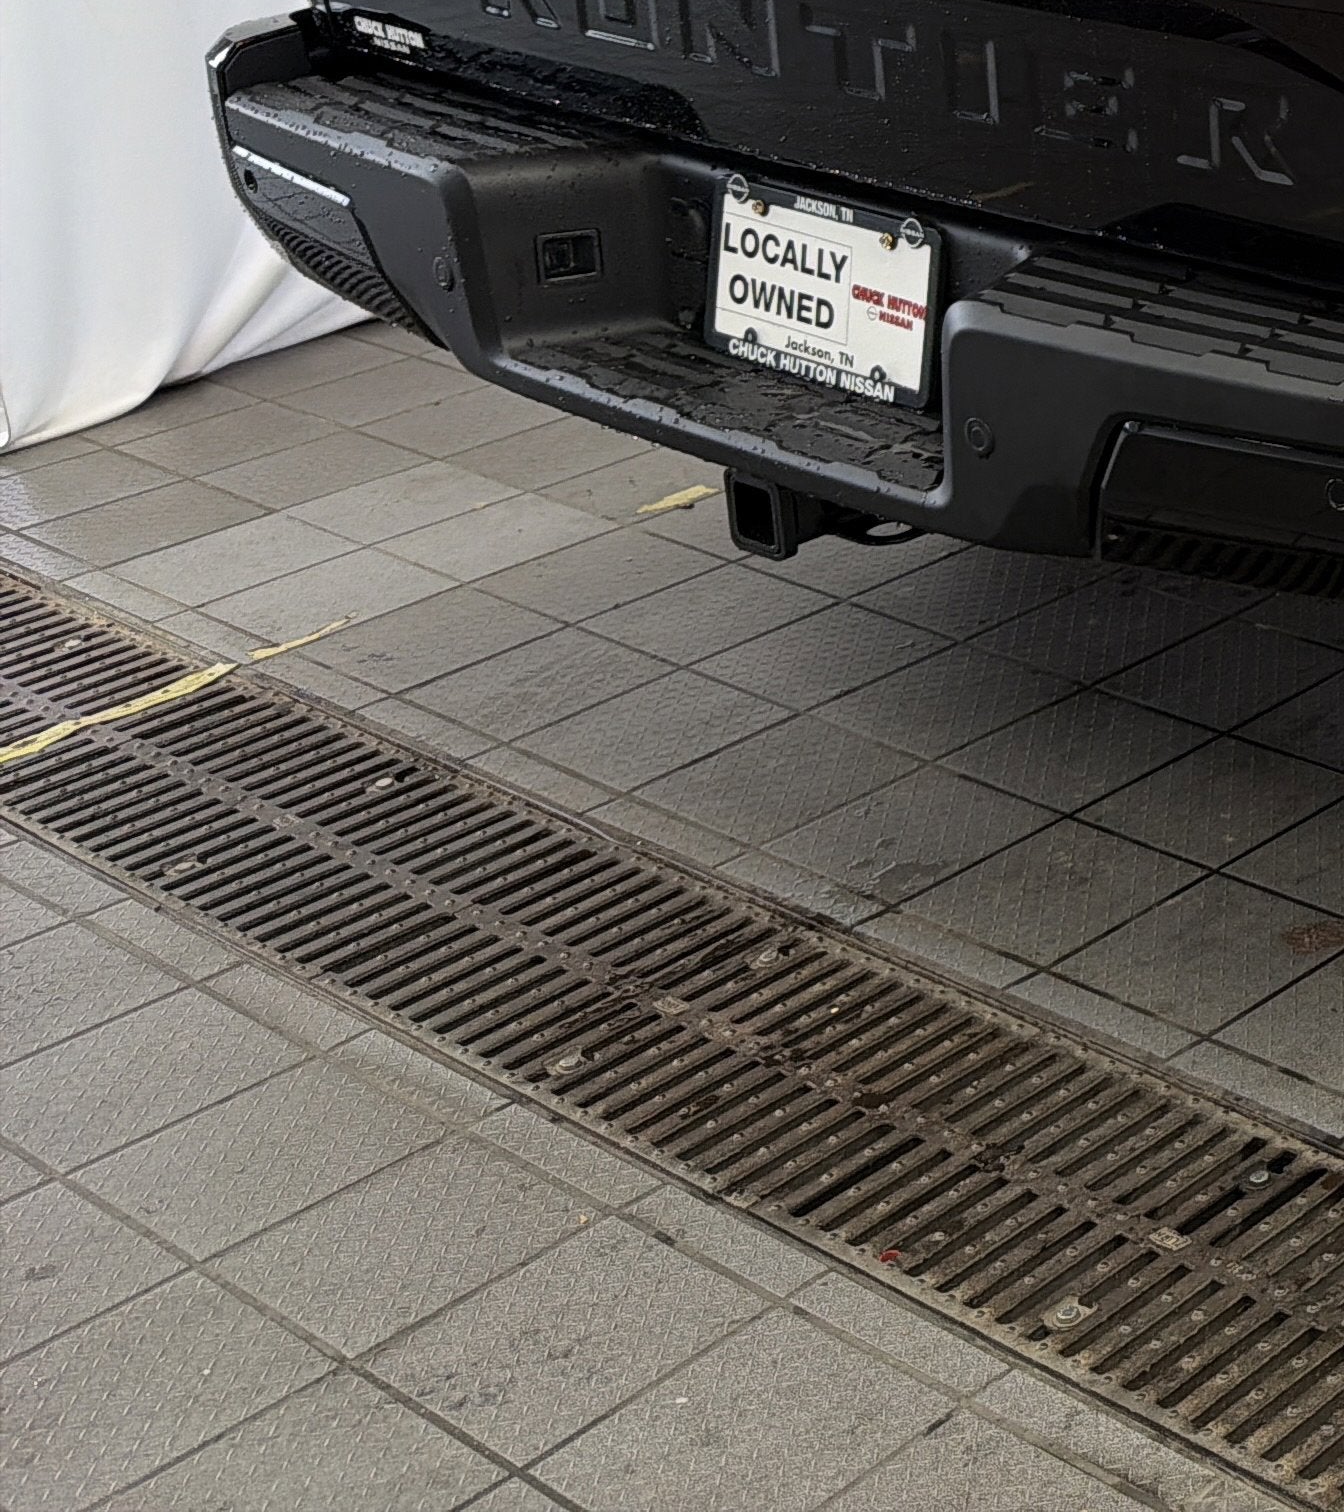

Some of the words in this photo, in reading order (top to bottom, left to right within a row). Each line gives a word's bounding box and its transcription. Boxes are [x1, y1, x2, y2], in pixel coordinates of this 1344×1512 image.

[793, 195, 839, 220] JACKSON,
[840, 207, 854, 224] TN
[723, 221, 849, 284] LOCALLY
[728, 274, 835, 330] OWNED
[851, 284, 885, 308] CHUCK
[887, 294, 929, 321] HUTTON
[878, 309, 914, 332] NISSAN
[785, 335, 834, 365] Jackson,
[838, 351, 855, 368] TN
[728, 338, 777, 368] CHUCK
[779, 353, 837, 386] HUTTON
[839, 371, 895, 403] NISSAN
